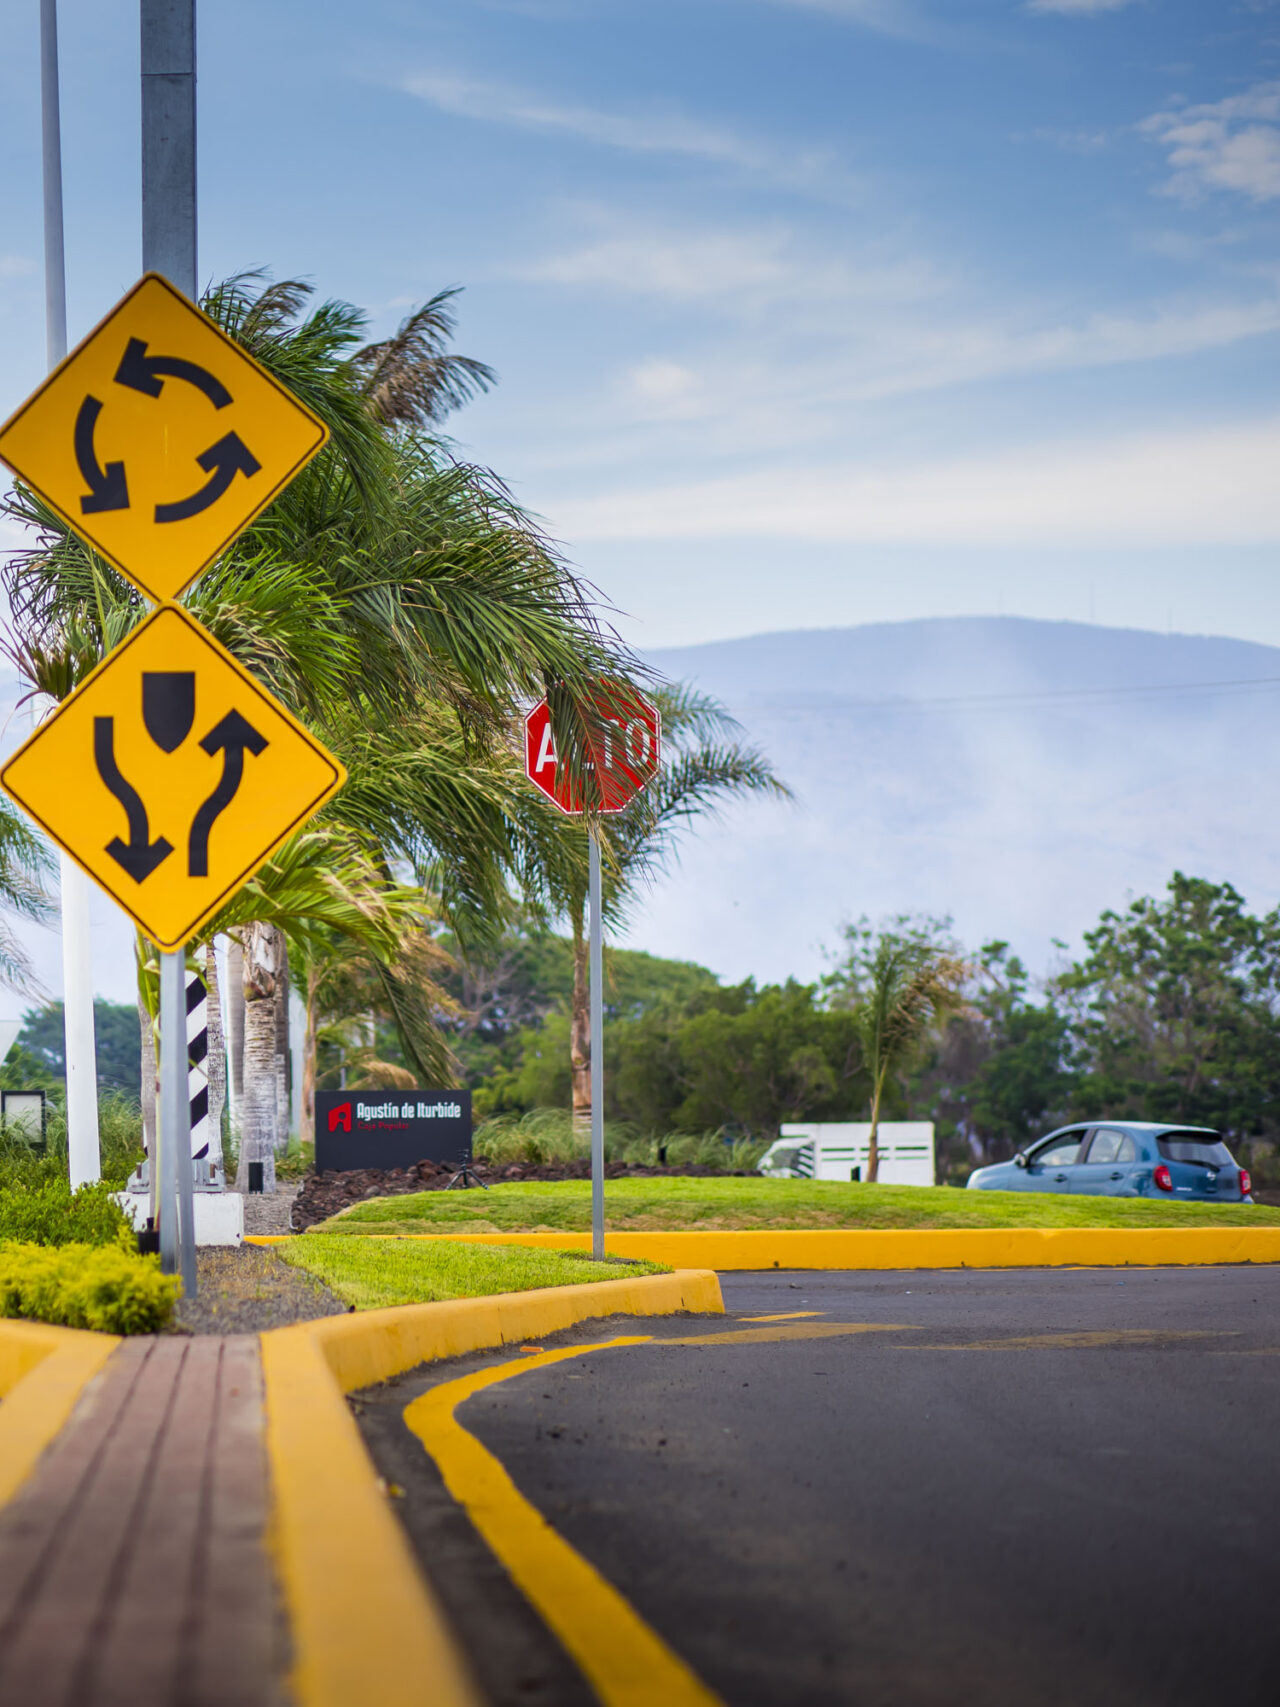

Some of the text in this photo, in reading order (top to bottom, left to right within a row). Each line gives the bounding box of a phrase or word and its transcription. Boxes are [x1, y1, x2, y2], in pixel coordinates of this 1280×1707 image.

[535, 718, 651, 773] ATO
[357, 1102, 461, 1121] Agustín de Iturbide
